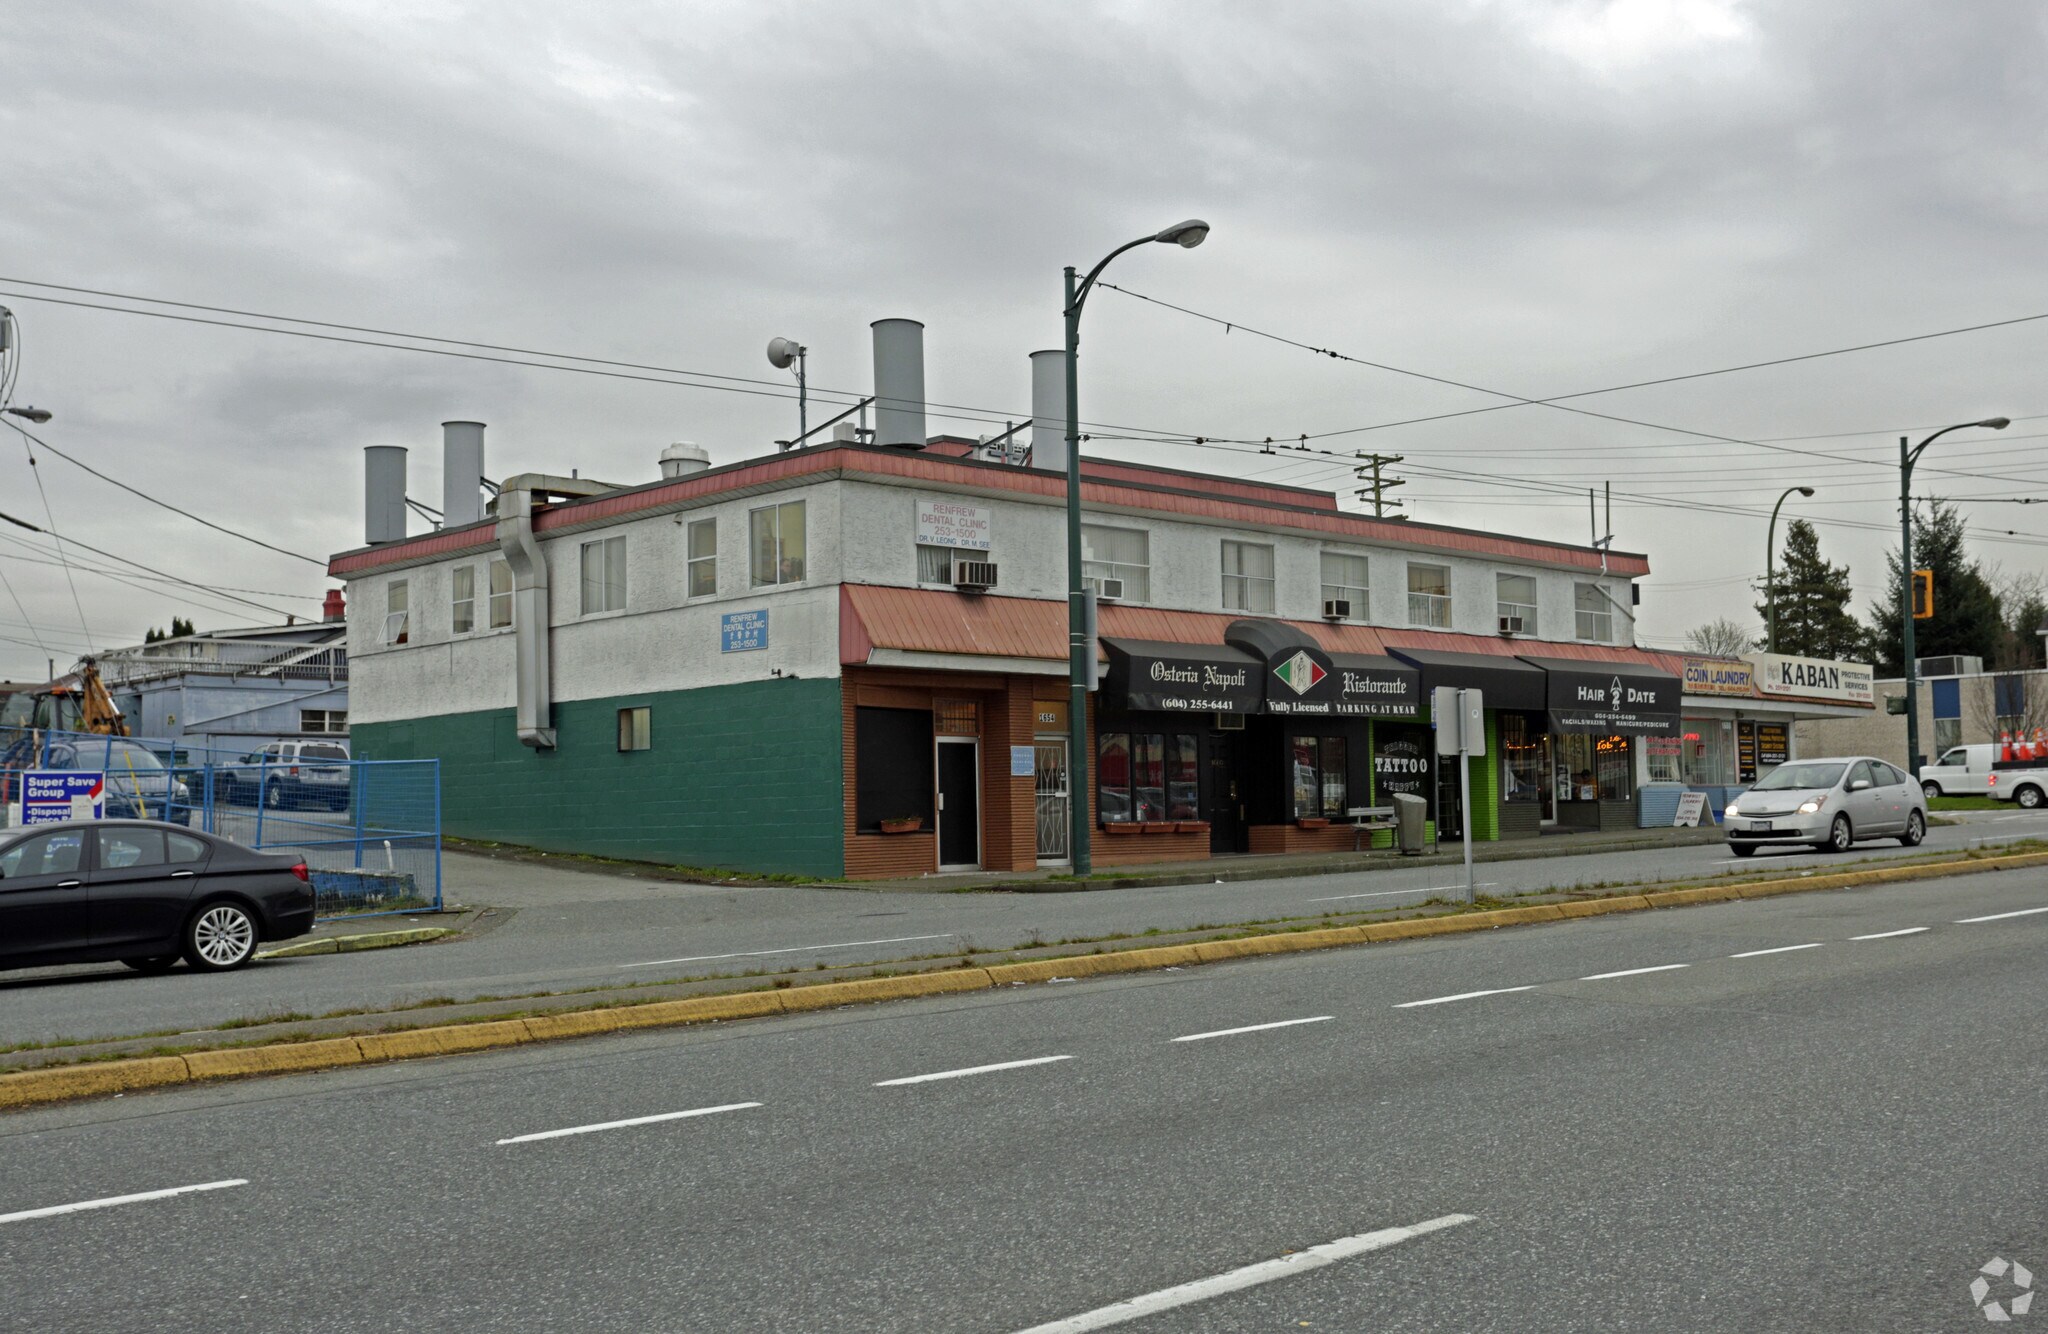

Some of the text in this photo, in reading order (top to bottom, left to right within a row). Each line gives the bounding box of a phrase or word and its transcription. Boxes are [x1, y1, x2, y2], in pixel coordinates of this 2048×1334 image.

[933, 504, 976, 517] RENFREW
[921, 513, 987, 530] DENTAL CLINIC
[934, 526, 977, 539] 253-1500
[936, 537, 957, 545] LEONG
[978, 541, 991, 549] SEE
[730, 612, 758, 623] RENFREW
[723, 620, 765, 632] DENTAL CLINIC
[1150, 661, 1245, 692] Osteria Napoli
[1686, 668, 1708, 682] COIN
[1710, 670, 1751, 686] LAUNDRY
[1781, 662, 1839, 690] KABAN
[1841, 670, 1871, 681] PROTECTIVE
[1341, 672, 1407, 699] Ristorante
[1844, 681, 1868, 691] SERVICES
[1577, 686, 1656, 705] HAIR 2 DATE
[1162, 698, 1233, 710] (604) 255-6441
[1268, 701, 1329, 714] Fully Licensed
[1336, 703, 1416, 715] PARKING AT REAR
[1374, 757, 1428, 774] TATTOO
[28, 777, 96, 788] Super Save
[28, 788, 65, 798] Group
[31, 807, 71, 817] Disposal
